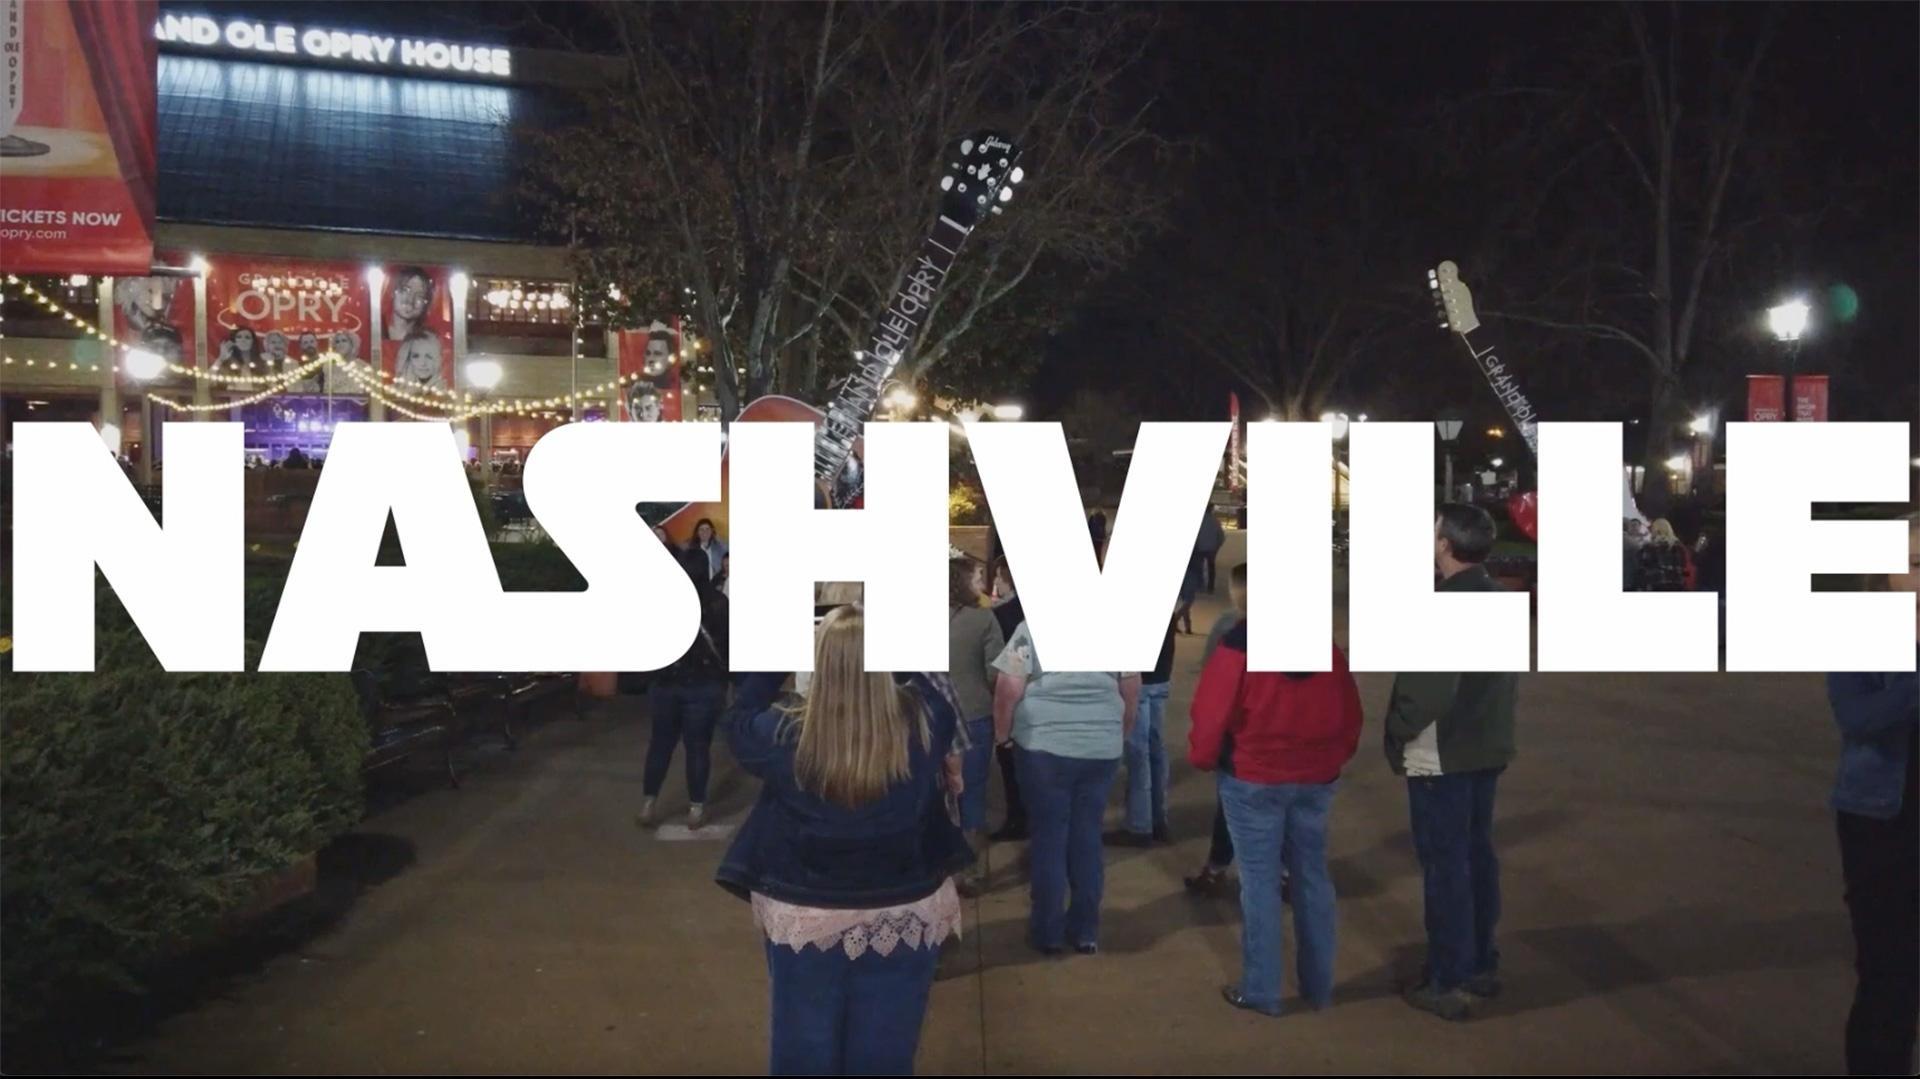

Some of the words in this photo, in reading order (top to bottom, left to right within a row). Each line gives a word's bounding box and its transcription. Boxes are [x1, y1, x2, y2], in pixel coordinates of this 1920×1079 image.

[225, 21, 297, 53] OLE
[302, 29, 395, 63] OPRY
[400, 39, 511, 76] HOUSE
[8, 56, 18, 109] OPRY
[0, 228, 67, 240] opry.com
[72, 211, 122, 227] NOW
[900, 255, 936, 314] OPRY
[237, 290, 348, 322] OPRY
